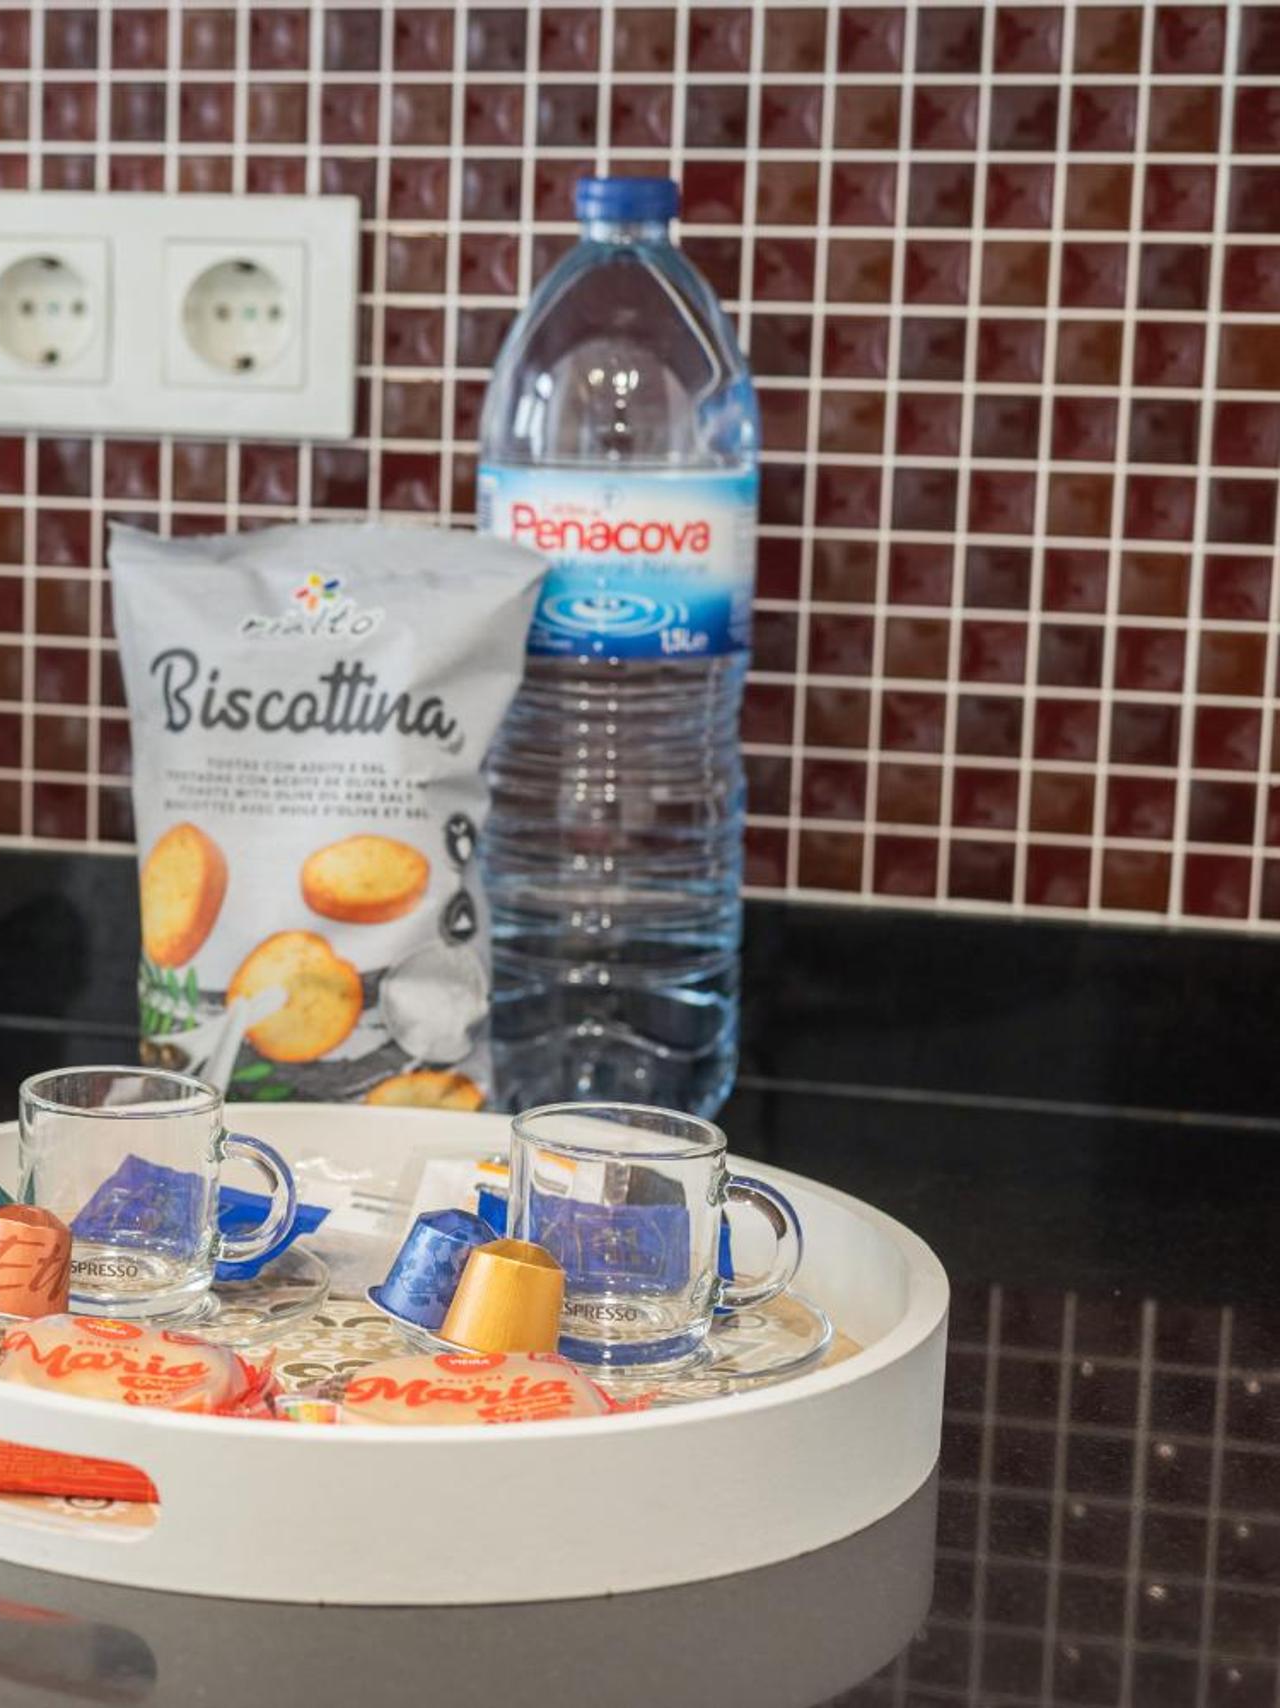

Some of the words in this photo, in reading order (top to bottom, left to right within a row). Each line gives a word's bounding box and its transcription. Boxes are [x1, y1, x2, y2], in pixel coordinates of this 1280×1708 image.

[512, 503, 711, 553] Penacova
[149, 647, 459, 741] Biscottina
[71, 1260, 138, 1278] SPRESSO
[564, 1301, 637, 1321] SPRESSO
[1, 1331, 209, 1378] Maria
[342, 1376, 572, 1407] Maria
